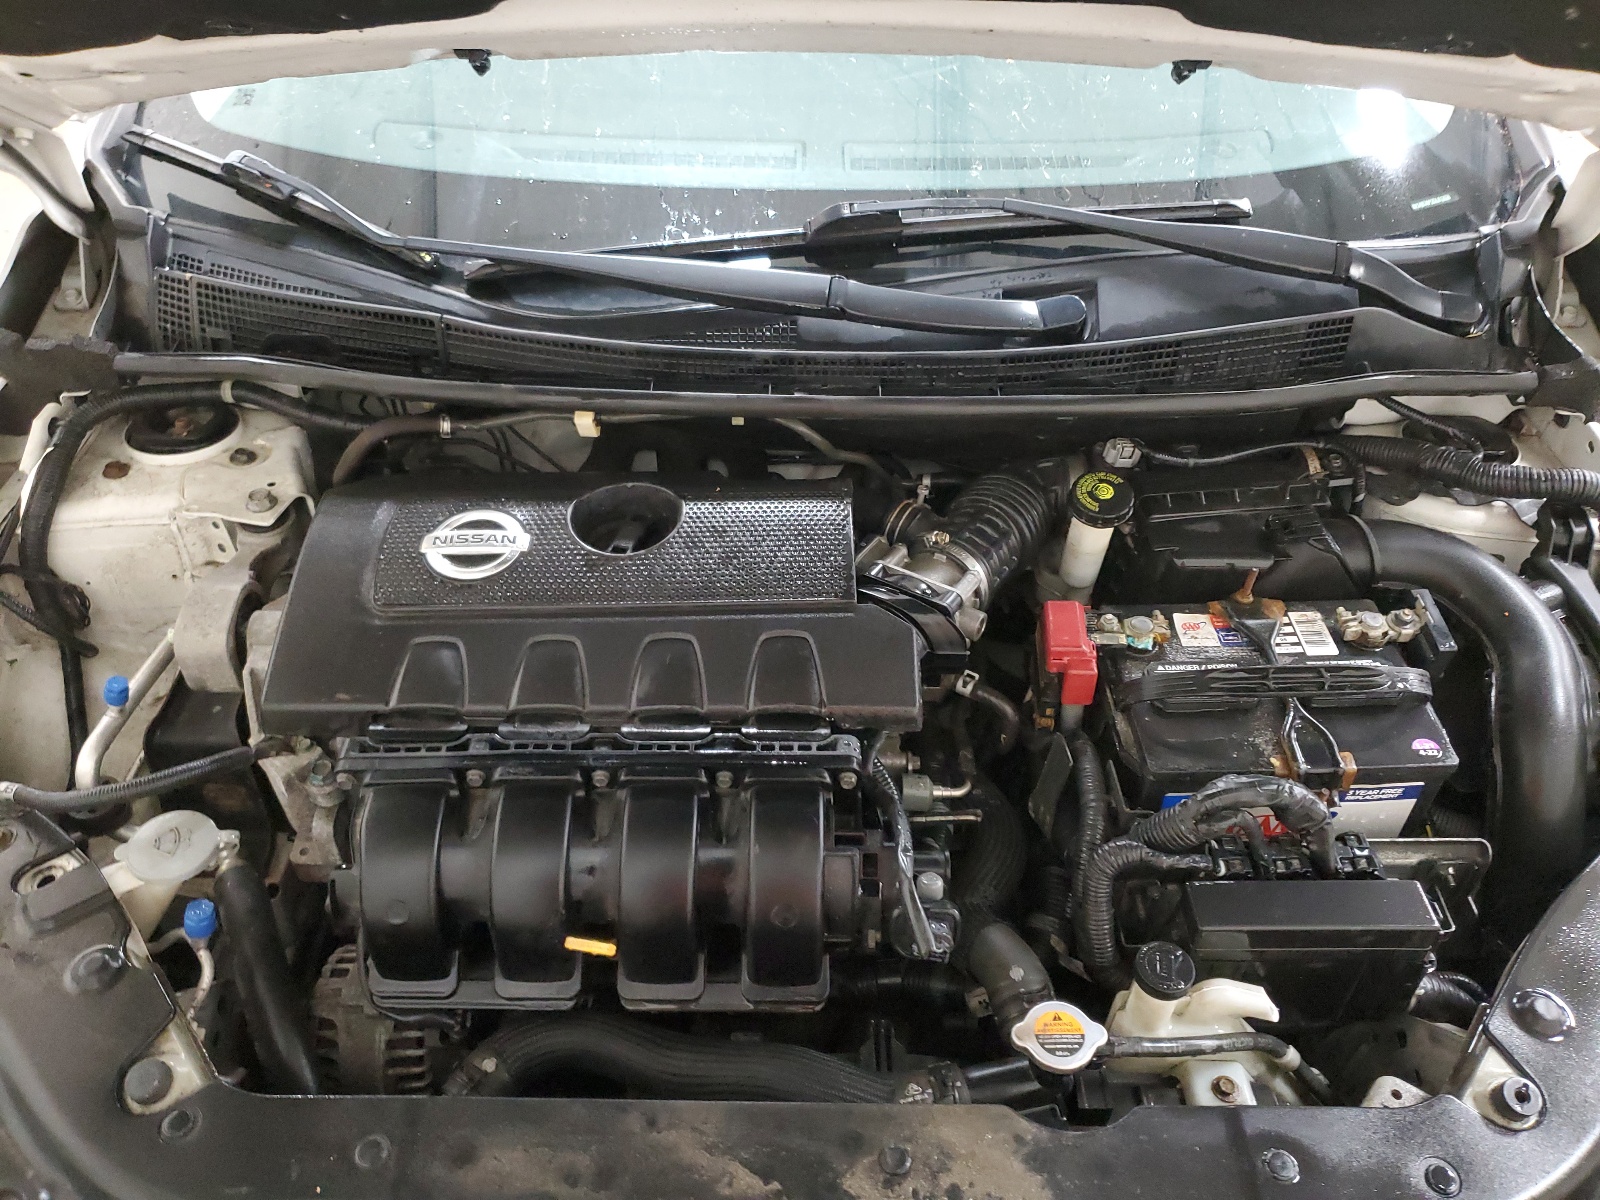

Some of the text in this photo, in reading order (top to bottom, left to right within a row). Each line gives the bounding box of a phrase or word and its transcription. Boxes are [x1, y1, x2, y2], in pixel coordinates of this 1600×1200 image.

[432, 533, 517, 546] NISSAN
[1181, 622, 1201, 631] AAA
[1379, 787, 1405, 795] FREE
